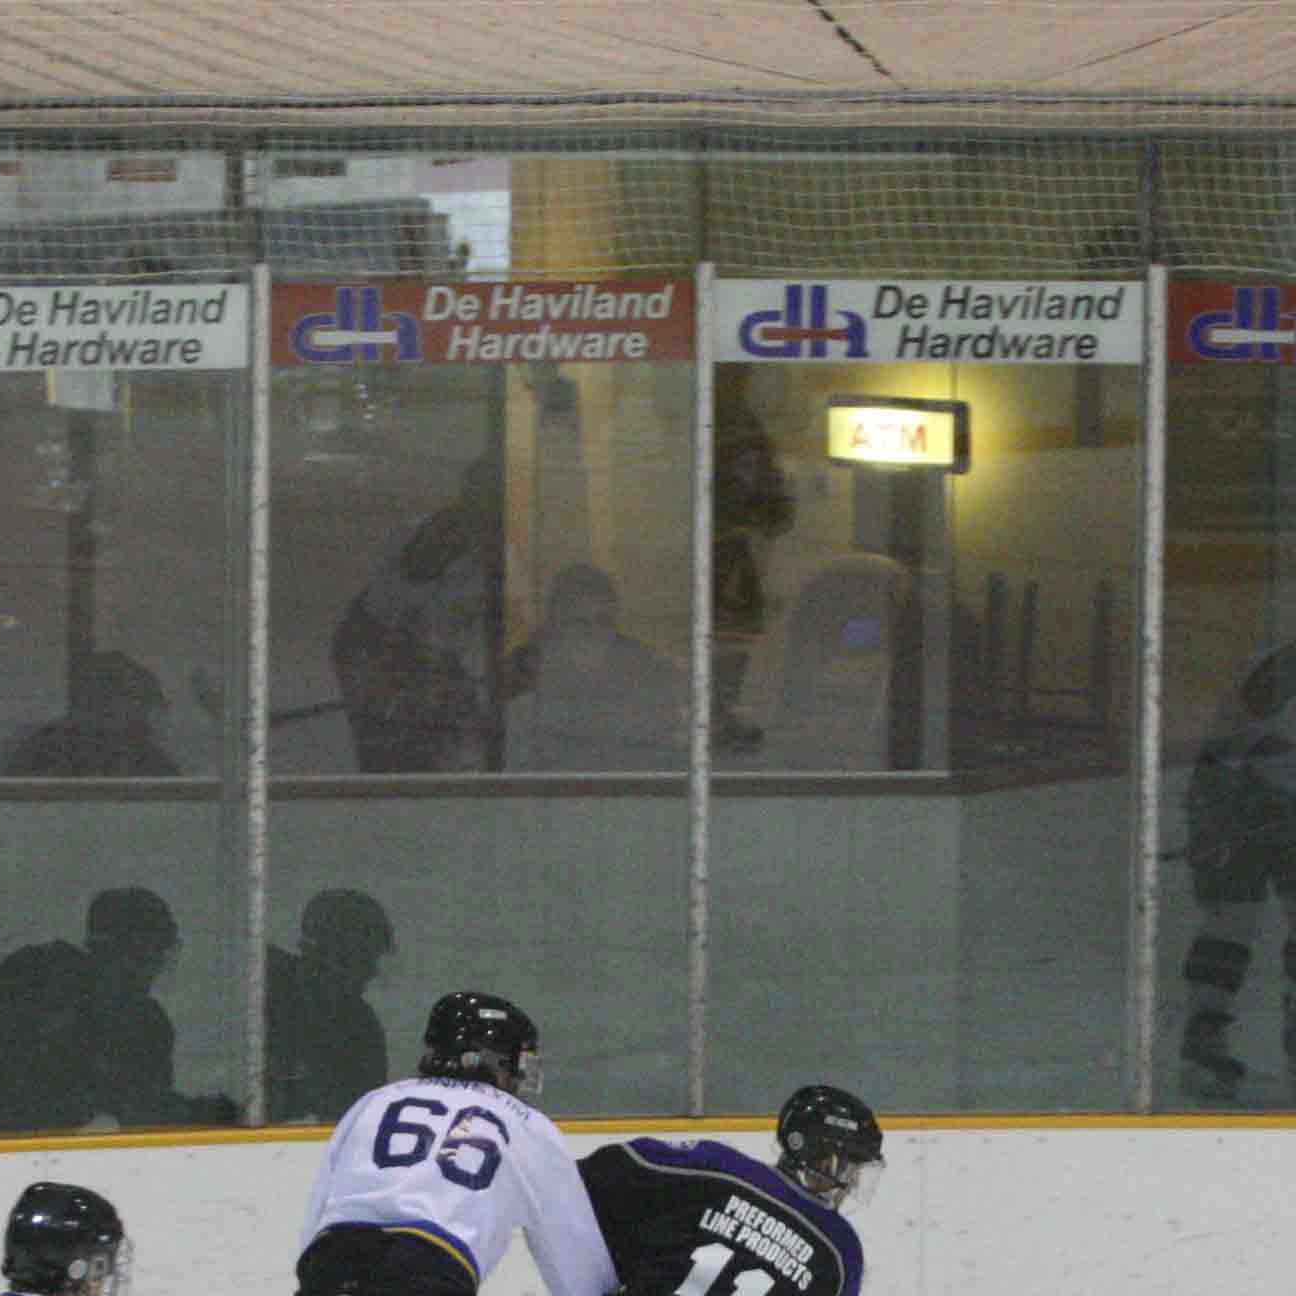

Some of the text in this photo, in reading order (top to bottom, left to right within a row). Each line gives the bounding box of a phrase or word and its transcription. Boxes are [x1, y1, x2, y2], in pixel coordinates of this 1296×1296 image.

[49, 284, 225, 326] Haviland
[424, 285, 673, 321] De Haviland
[873, 286, 1124, 320] De Haviland
[6, 331, 202, 365] Hardware
[445, 326, 649, 360] Hardware
[895, 326, 1098, 360] Hardware
[848, 422, 927, 453] ATM
[724, 1193, 815, 1264] PREFORMED
[699, 1207, 813, 1292] LINE PRODUCTS
